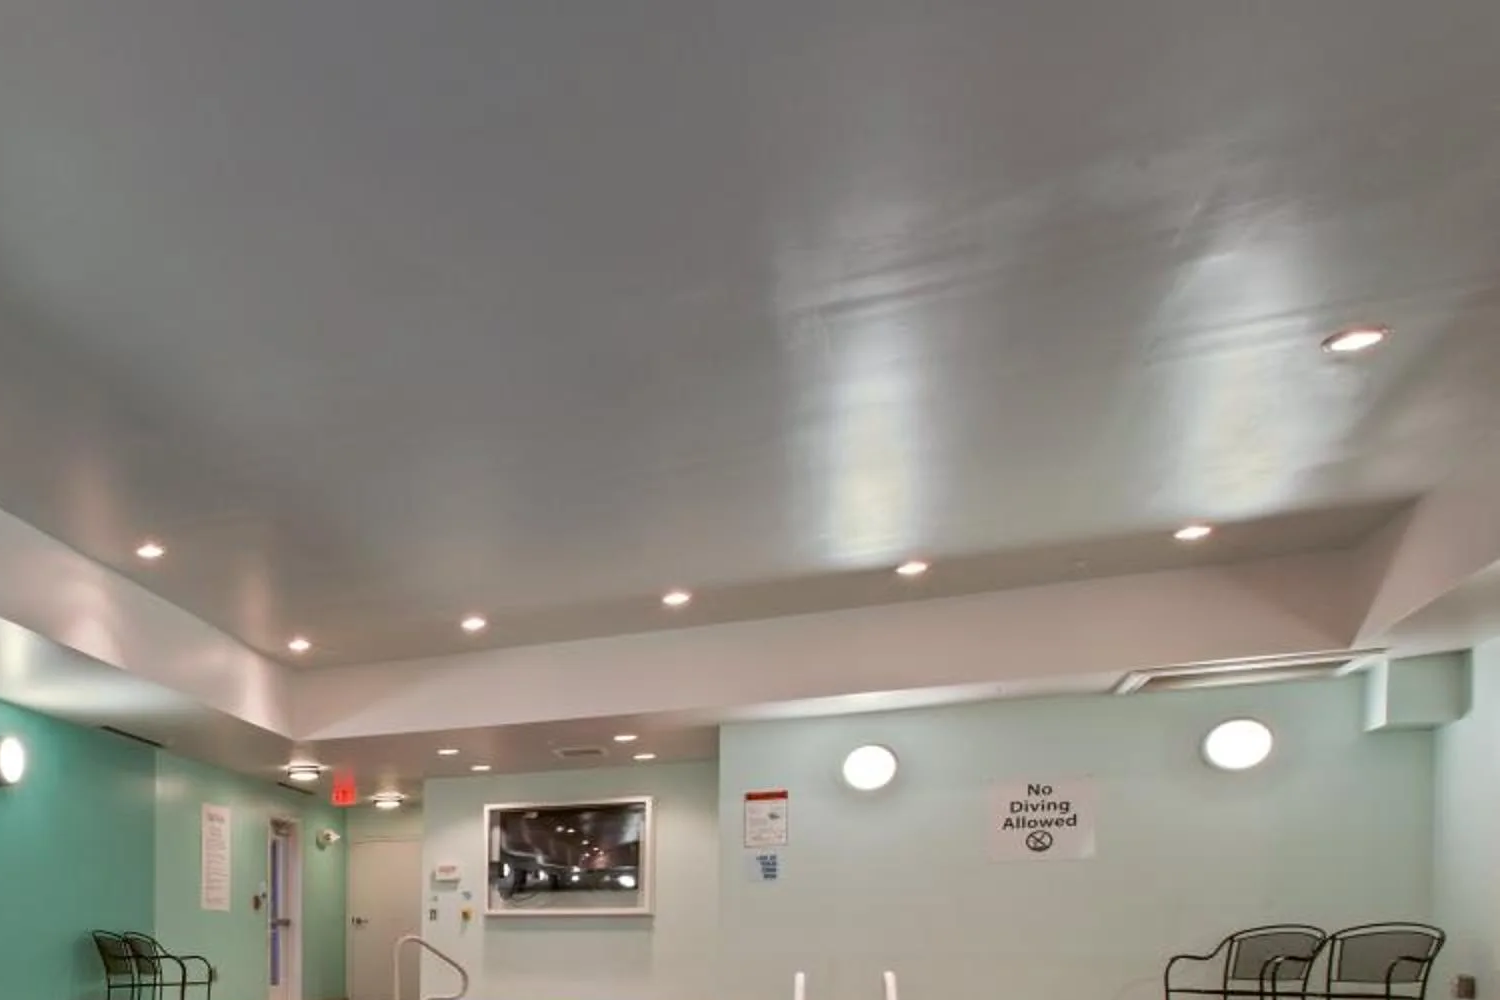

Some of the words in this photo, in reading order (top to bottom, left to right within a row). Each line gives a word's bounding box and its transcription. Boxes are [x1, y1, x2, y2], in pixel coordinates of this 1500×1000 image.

[1027, 783, 1053, 797] No
[1010, 799, 1070, 814] Diving
[1001, 813, 1077, 830] Allowed
